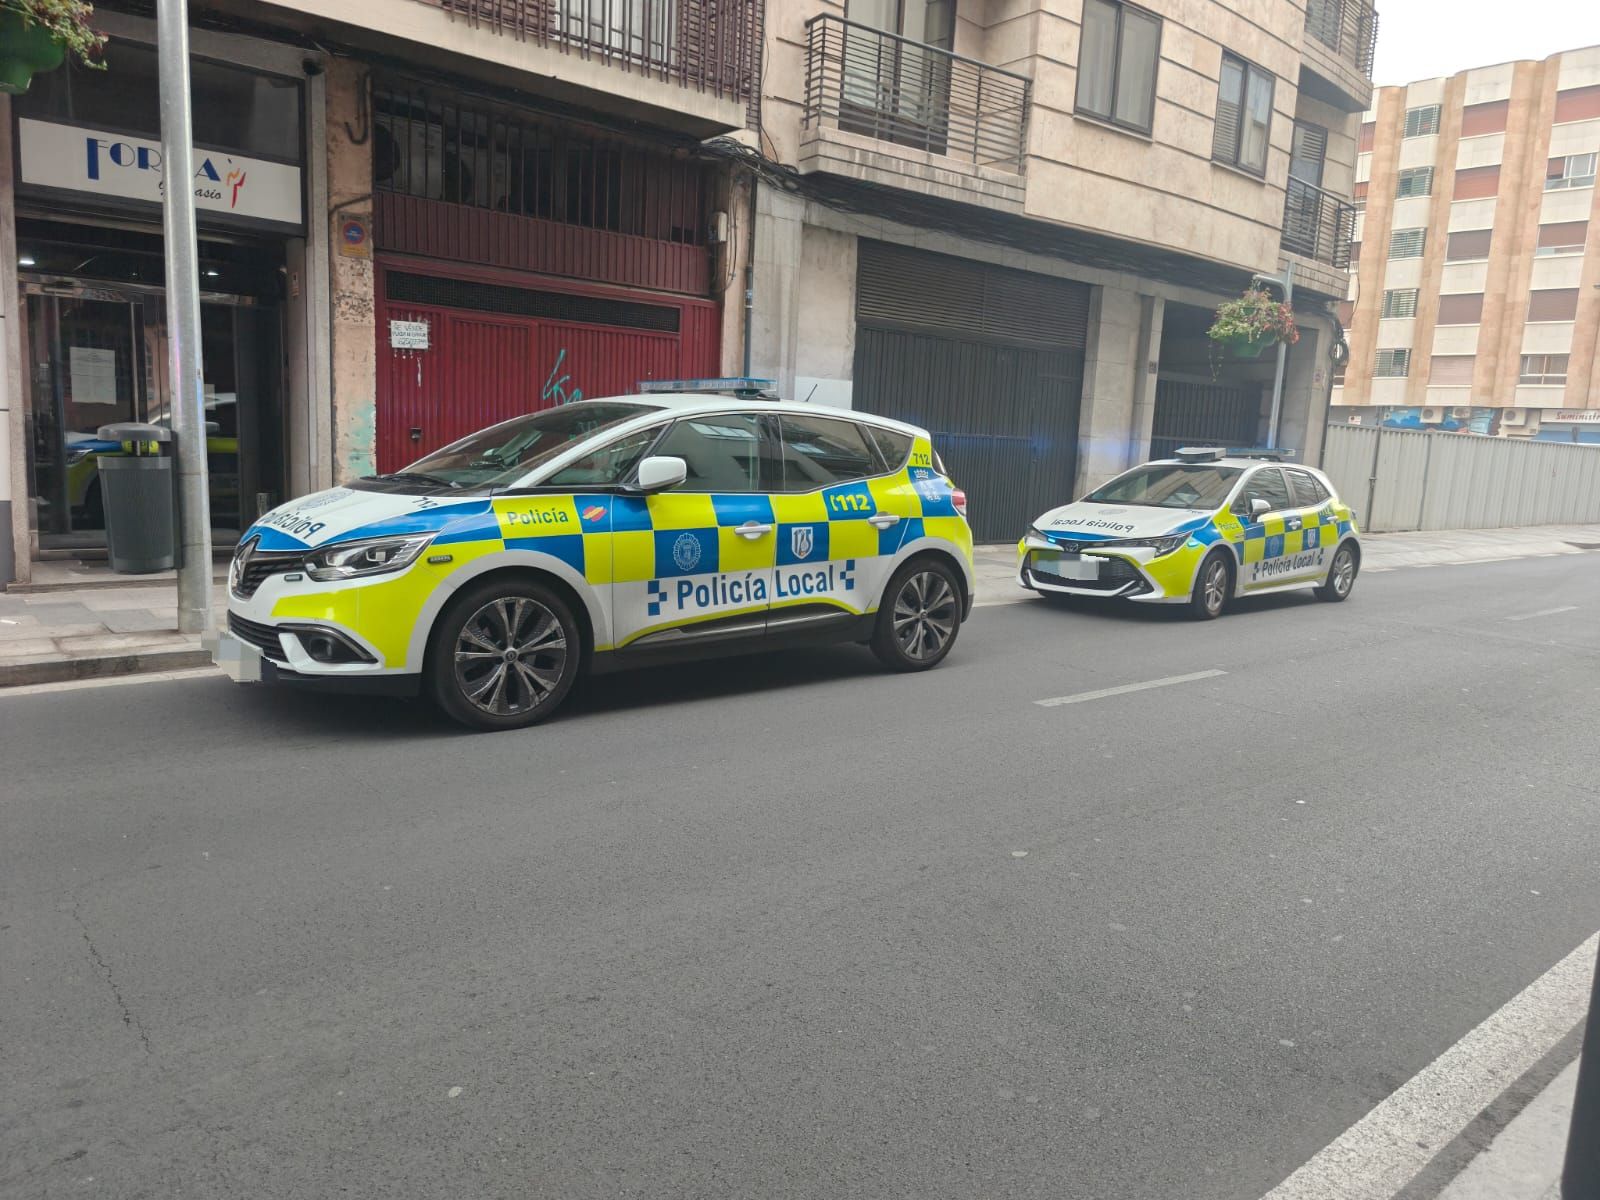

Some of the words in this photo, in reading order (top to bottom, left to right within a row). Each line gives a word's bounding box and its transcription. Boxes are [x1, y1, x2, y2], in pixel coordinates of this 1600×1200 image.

[87, 137, 221, 182] FORA
[912, 452, 930, 465] 712
[836, 494, 872, 511] 112
[506, 508, 569, 526] Policía
[1292, 551, 1316, 570] Local
[677, 573, 767, 610] Policía
[775, 564, 834, 598] Local
